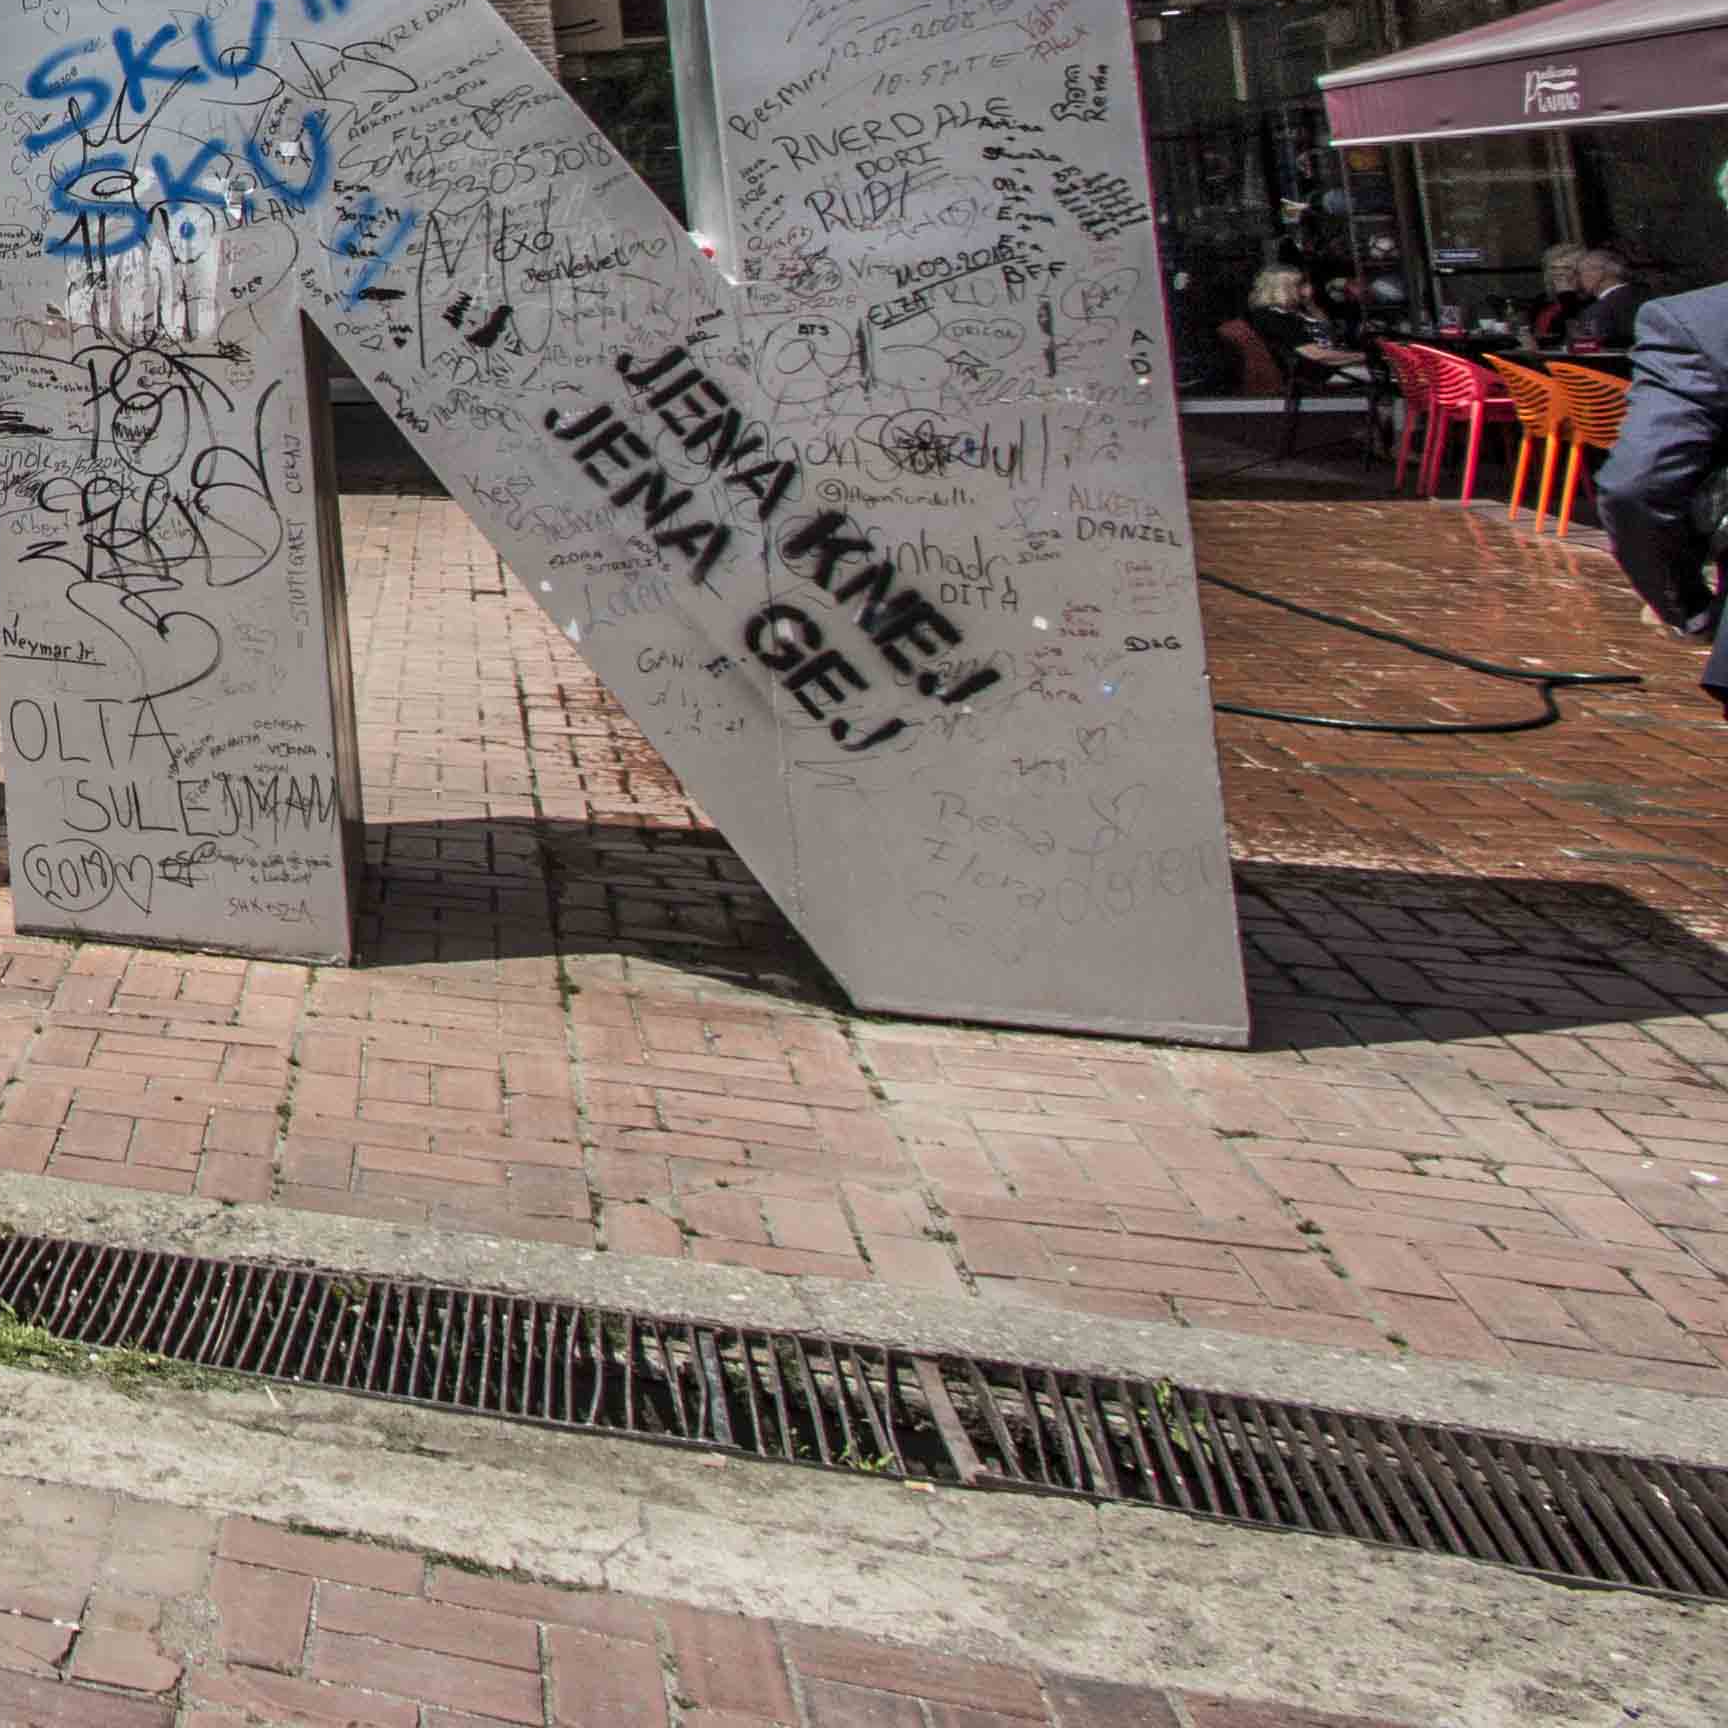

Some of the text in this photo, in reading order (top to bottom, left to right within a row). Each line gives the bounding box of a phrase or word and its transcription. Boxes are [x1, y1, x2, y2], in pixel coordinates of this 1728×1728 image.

[614, 345, 796, 521] JENA
[544, 403, 732, 586] JENA
[1076, 517, 1184, 547] DANIEL
[2, 626, 73, 660] Neymar
[10, 694, 180, 771] OLTA
